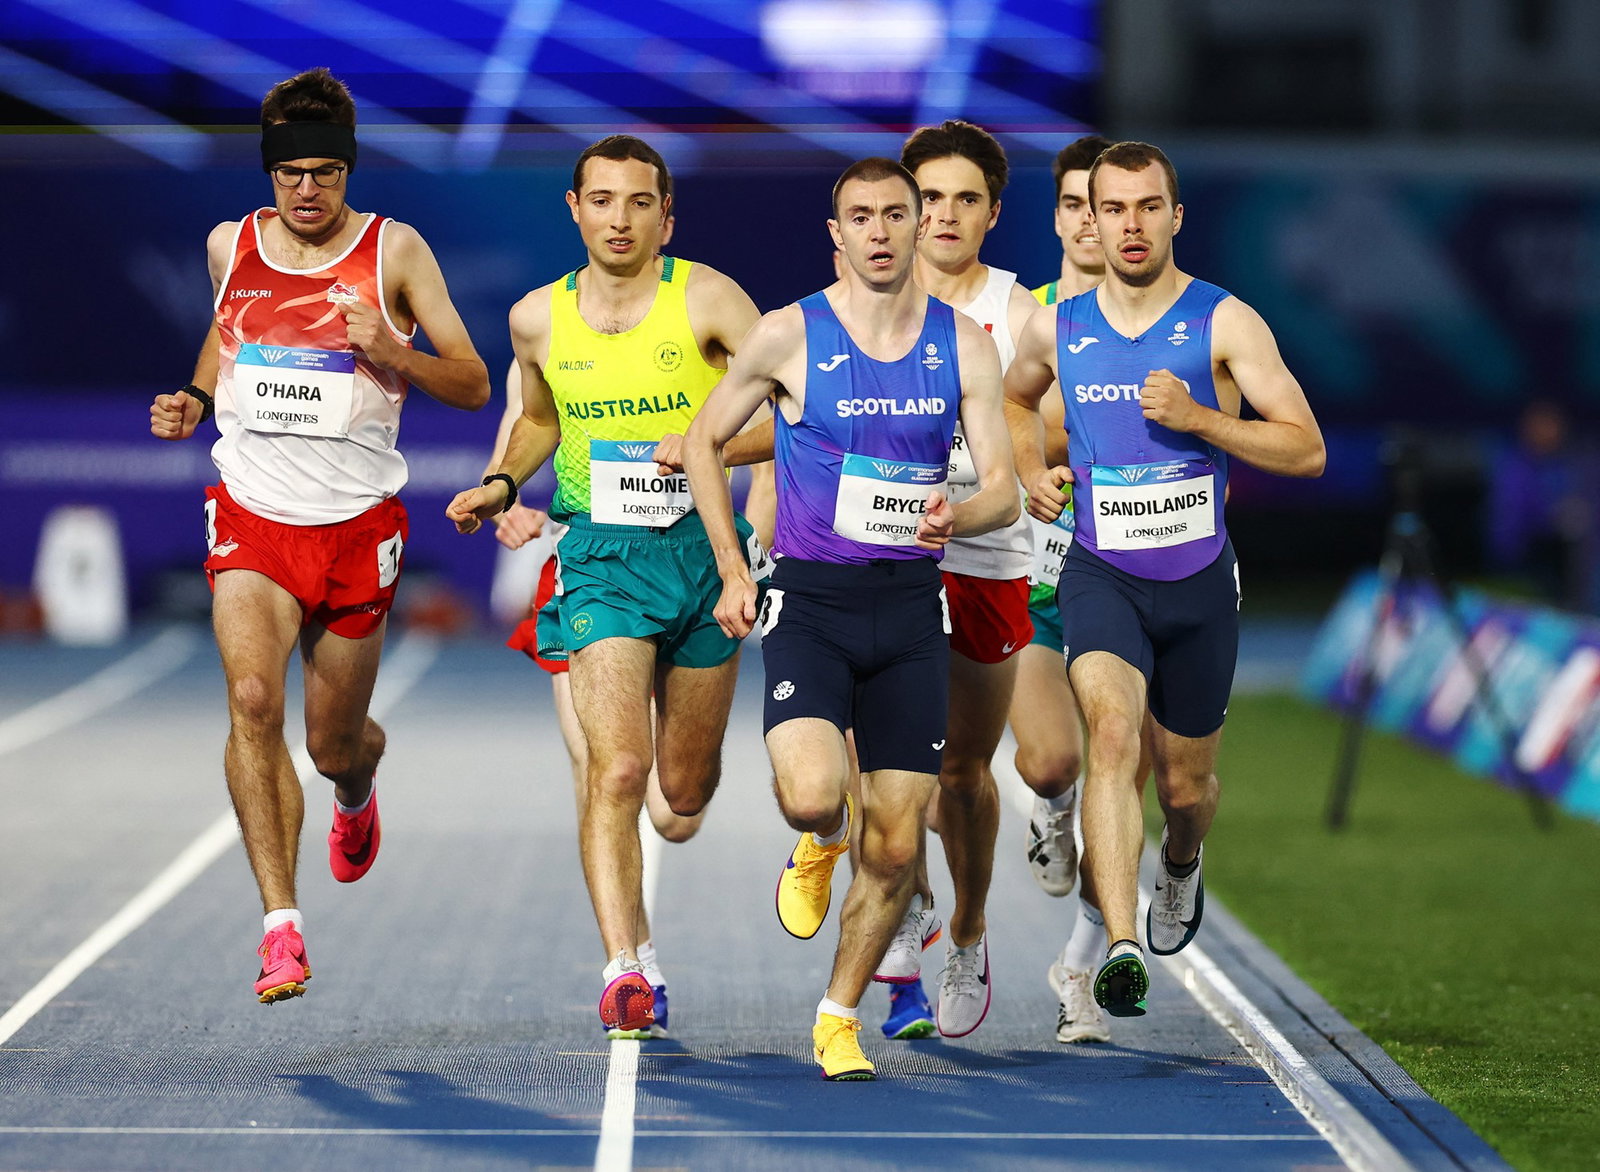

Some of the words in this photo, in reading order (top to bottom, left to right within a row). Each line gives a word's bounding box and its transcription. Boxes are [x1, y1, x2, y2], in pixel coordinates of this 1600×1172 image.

[235, 288, 272, 299] KUKRI
[558, 360, 595, 371] VALOUR
[256, 381, 322, 402] O'HARA
[566, 391, 692, 420] AUSTRALIA
[836, 397, 946, 418] SCOTLAND
[256, 410, 319, 424] LONGINES
[620, 477, 688, 494] MILONE
[623, 503, 686, 516] LONGINES
[872, 495, 927, 514] BRYCE
[1099, 490, 1208, 517] SANDILANDS
[865, 521, 918, 535] LONGIN
[1125, 522, 1188, 539] LONGINES
